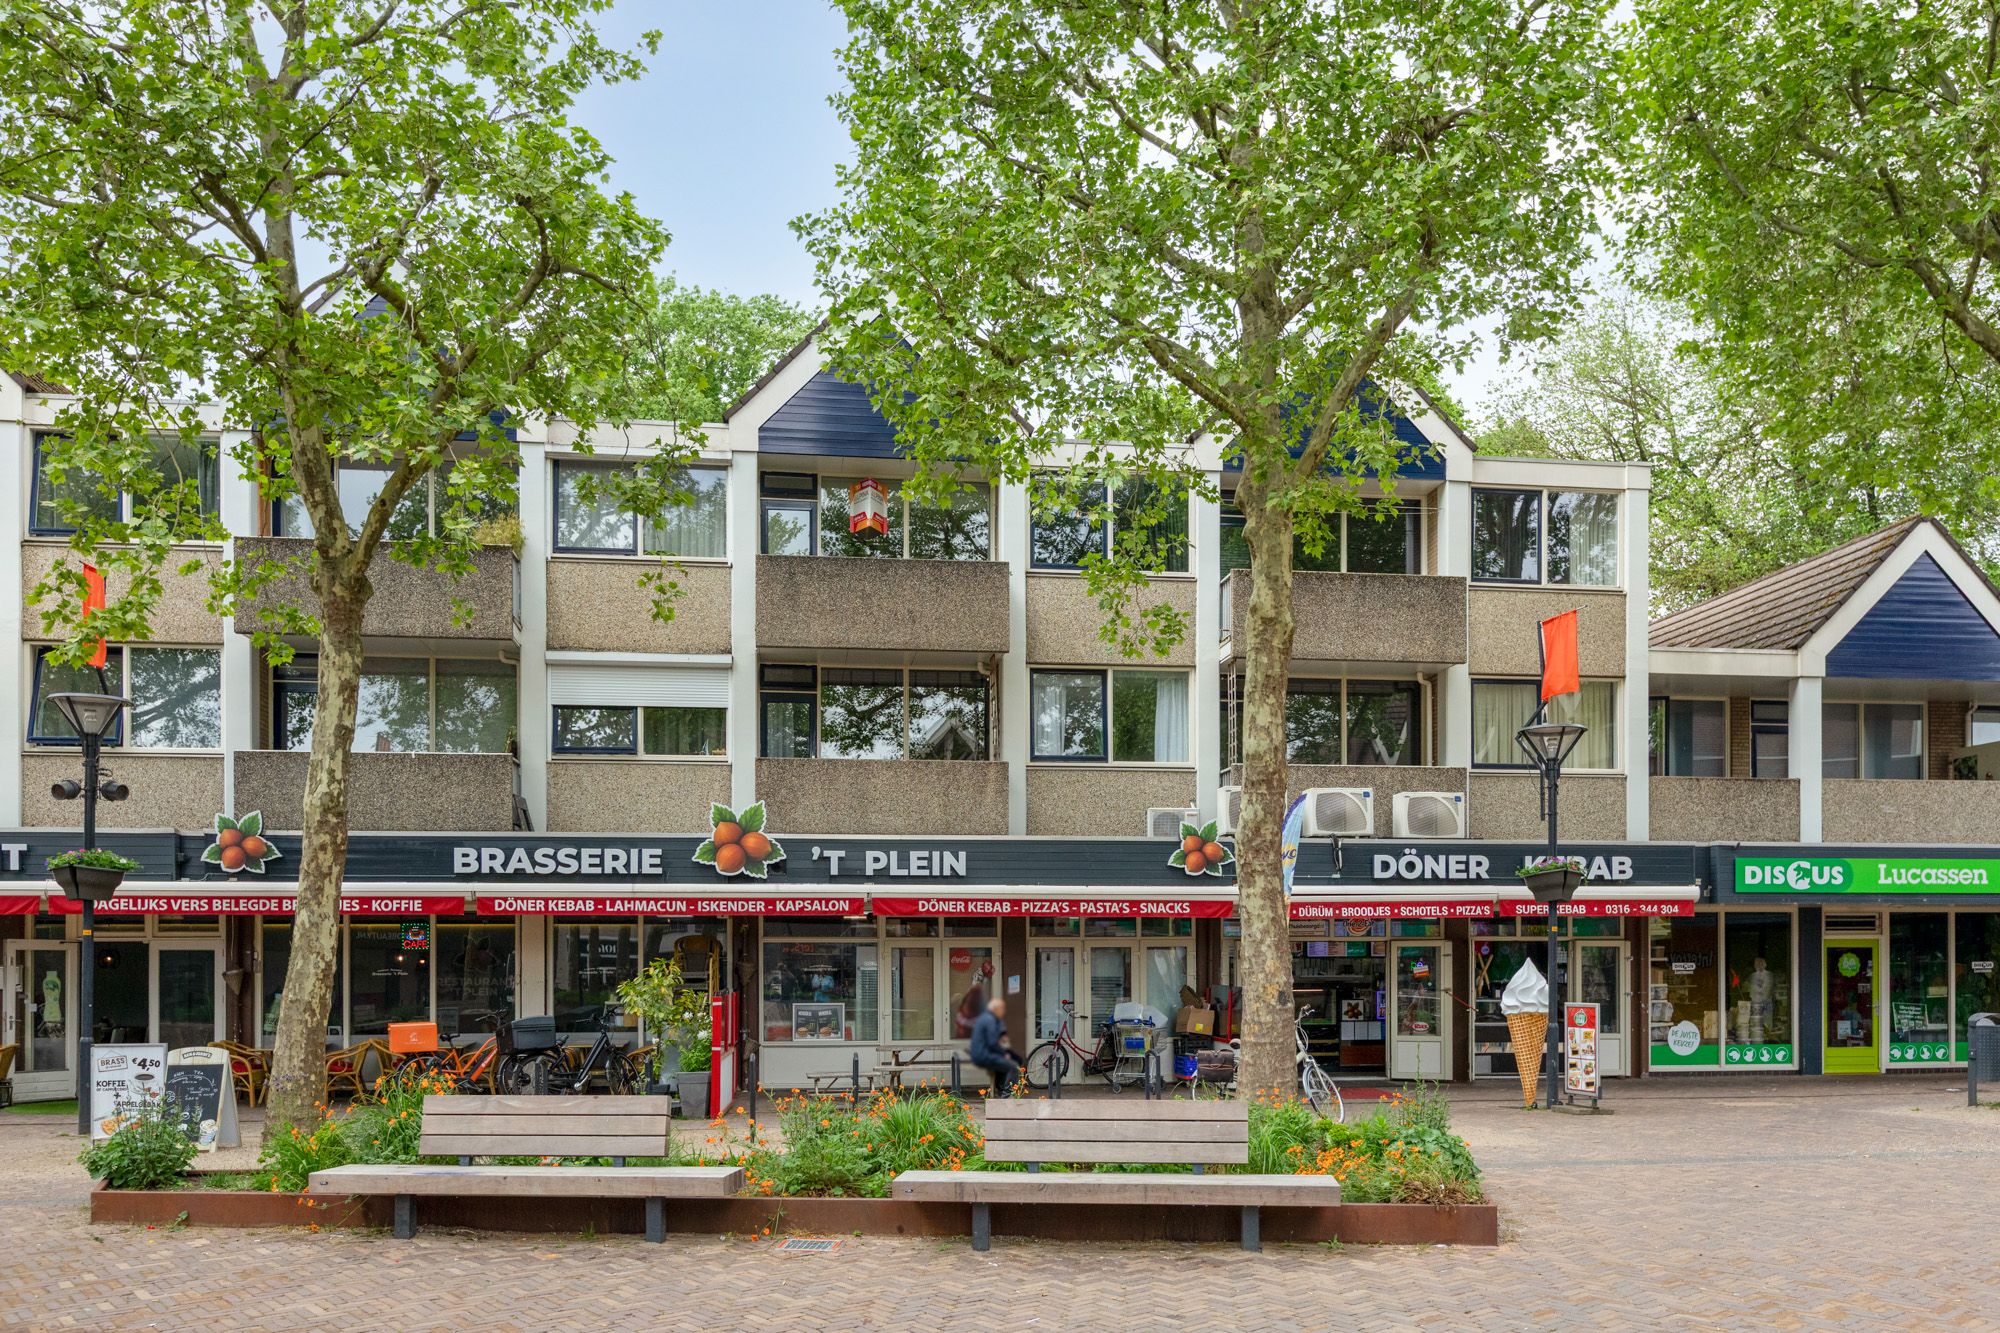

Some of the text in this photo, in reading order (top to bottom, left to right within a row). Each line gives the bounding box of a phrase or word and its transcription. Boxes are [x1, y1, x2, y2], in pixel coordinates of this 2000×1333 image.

[453, 847, 663, 875] BRASSERIE
[811, 846, 967, 877] 'T PLEIN
[1373, 848, 1490, 880] DÖNER
[1744, 861, 1989, 890] DISCUS Lucassen
[170, 899, 209, 911] VERS
[212, 899, 279, 911] BELEGDE
[371, 899, 423, 912] KOFFIE
[494, 897, 545, 912] DÖNER
[548, 900, 595, 912] KEBAB
[605, 900, 687, 912] LAHMACUN
[697, 900, 765, 912] ISKENDER
[776, 900, 849, 912] KAPSALON
[918, 898, 965, 913] DÖNER
[967, 901, 1011, 913] KEBAB
[1021, 901, 1070, 913] PIZZA'S
[1079, 902, 1131, 914] PASTA'S
[1139, 902, 1191, 914] SNACKS
[1298, 905, 1490, 917] DÜRÜM BROODJES SCHOTELS PIZZA'S
[1515, 904, 1549, 915] SUPER
[1605, 904, 1631, 914] 0316
[1639, 904, 1659, 913] 344
[1660, 904, 1680, 914] 304
[100, 1057, 125, 1067] BRASS
[131, 1057, 161, 1072] €4,50
[96, 1080, 126, 1088] KOFFIE
